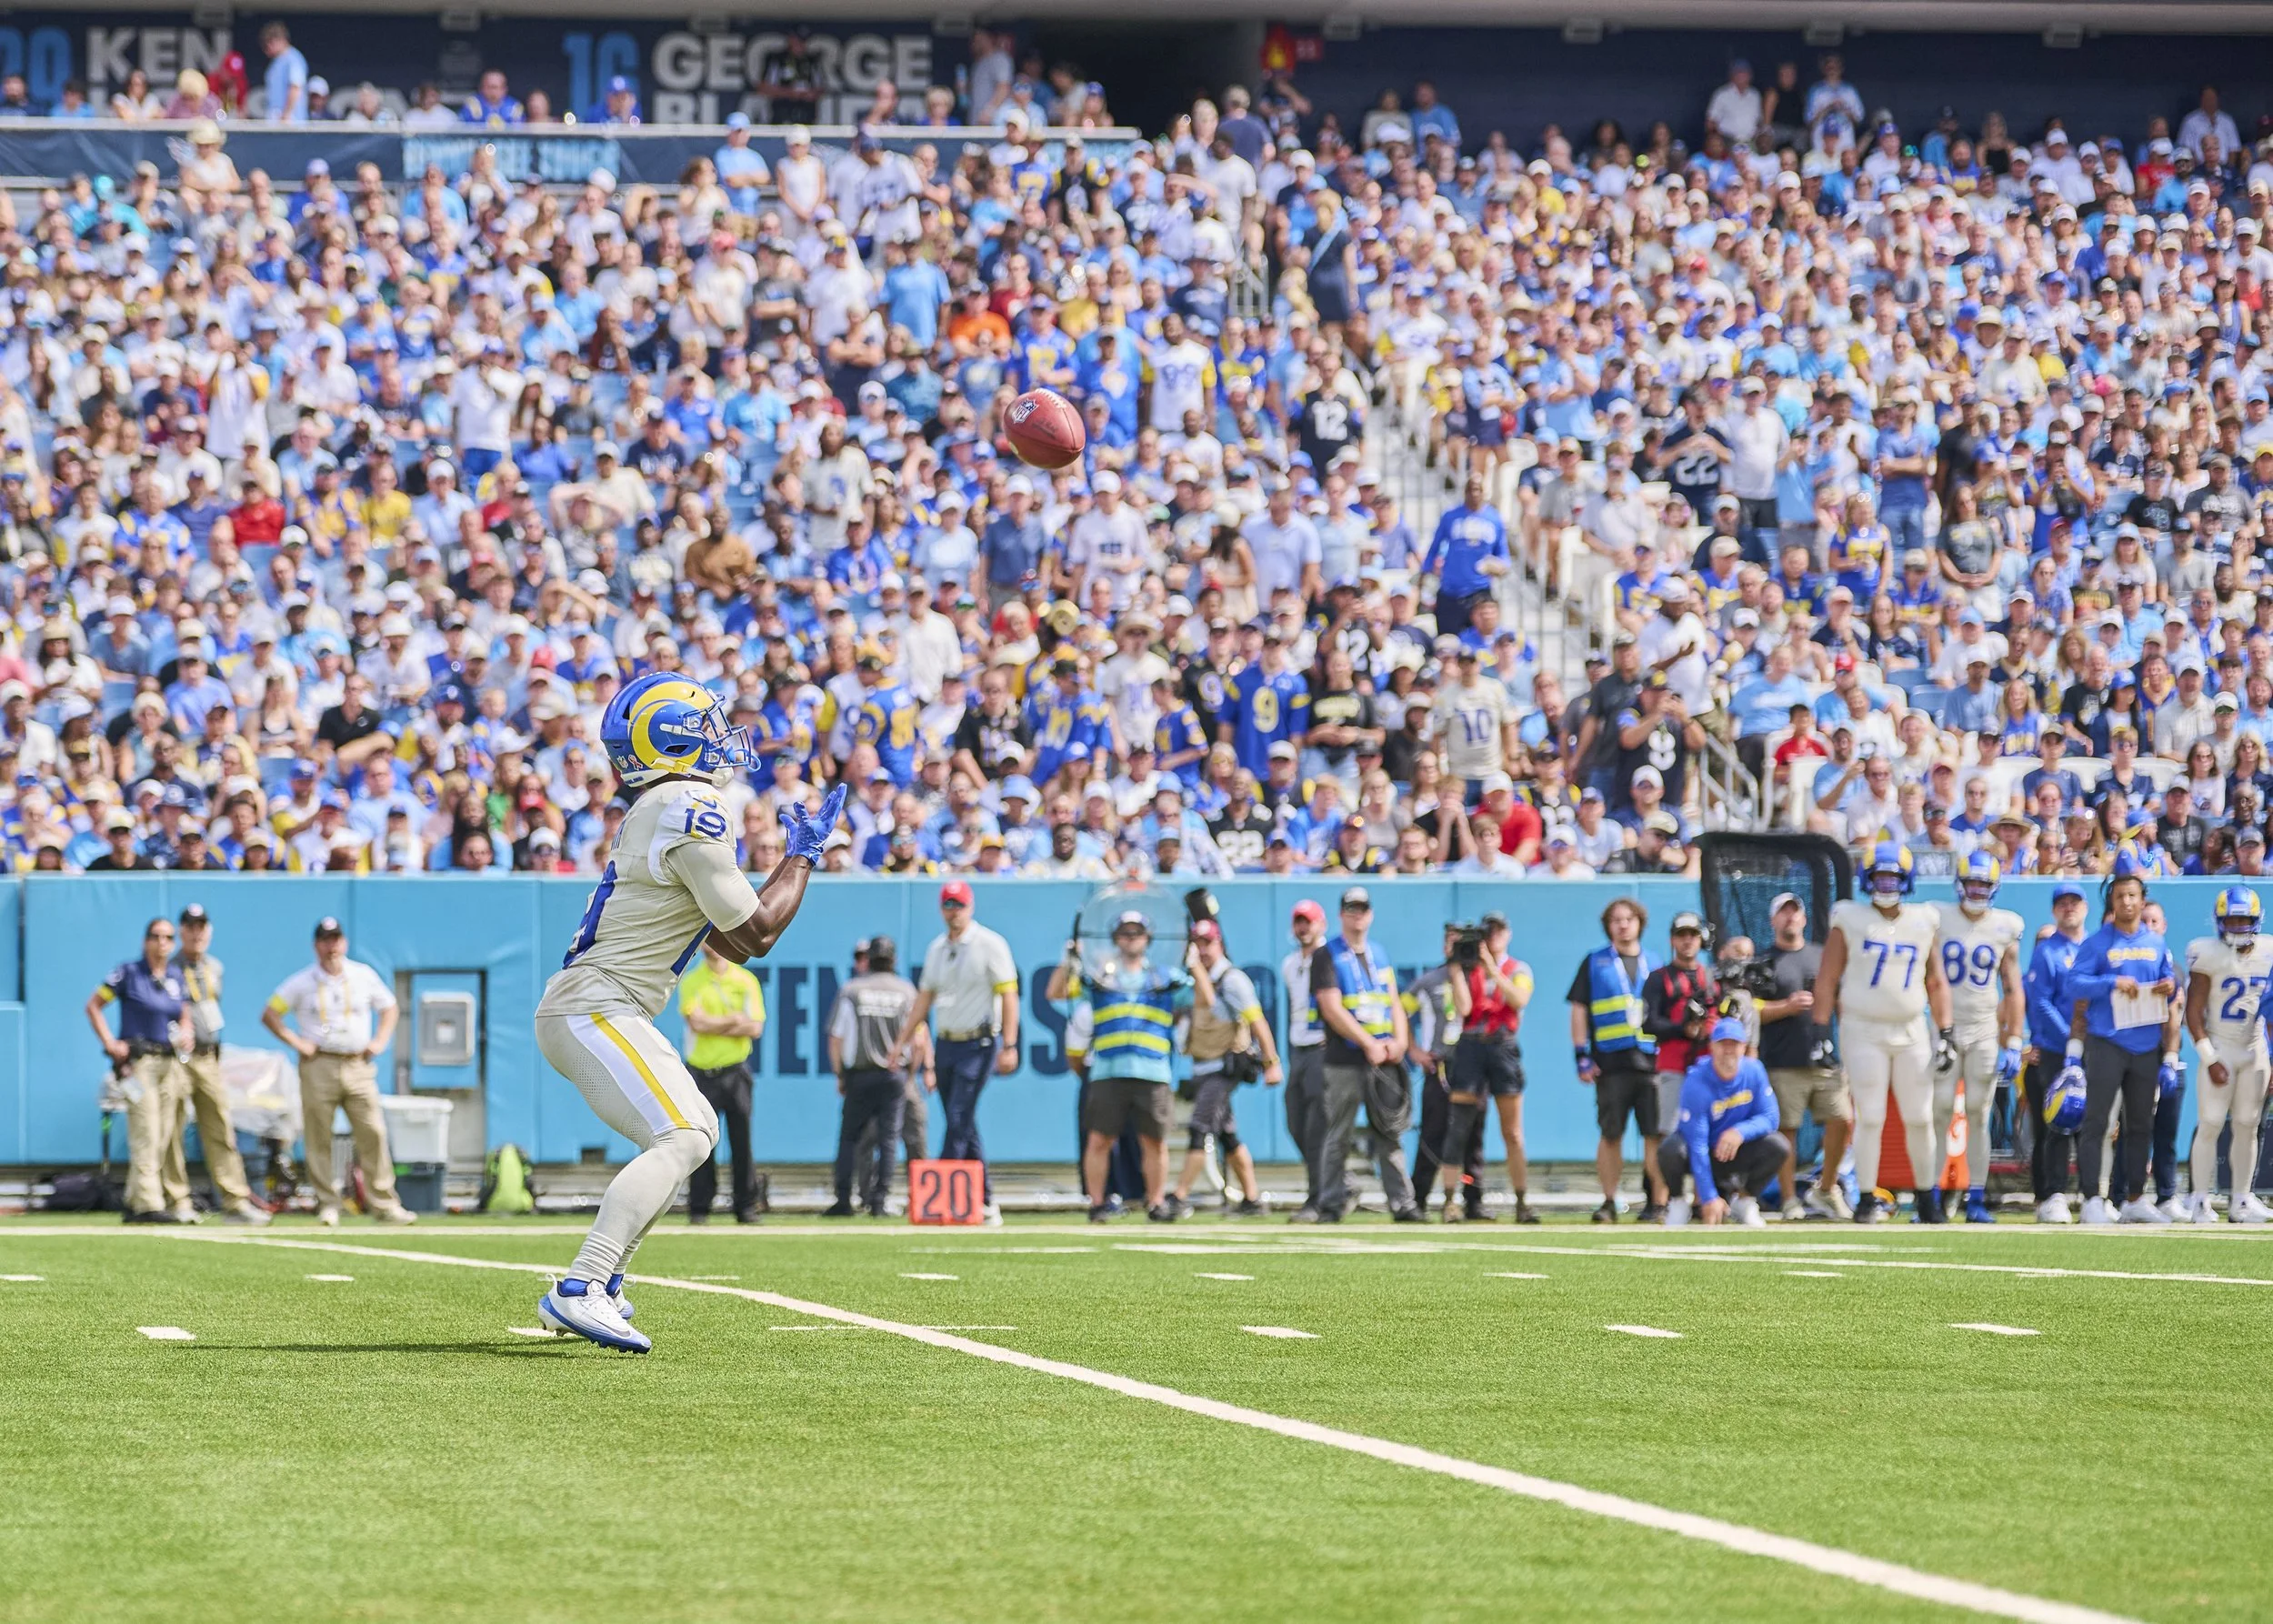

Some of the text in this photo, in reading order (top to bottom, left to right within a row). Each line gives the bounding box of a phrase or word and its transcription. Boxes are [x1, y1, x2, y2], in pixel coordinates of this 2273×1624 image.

[86, 26, 231, 84] KEN
[1253, 686, 1278, 733] 9
[1454, 708, 1493, 744] 10
[685, 807, 727, 837] 19
[1863, 939, 1918, 988] 77
[1941, 940, 1997, 987] 89
[921, 1169, 973, 1220] 20
